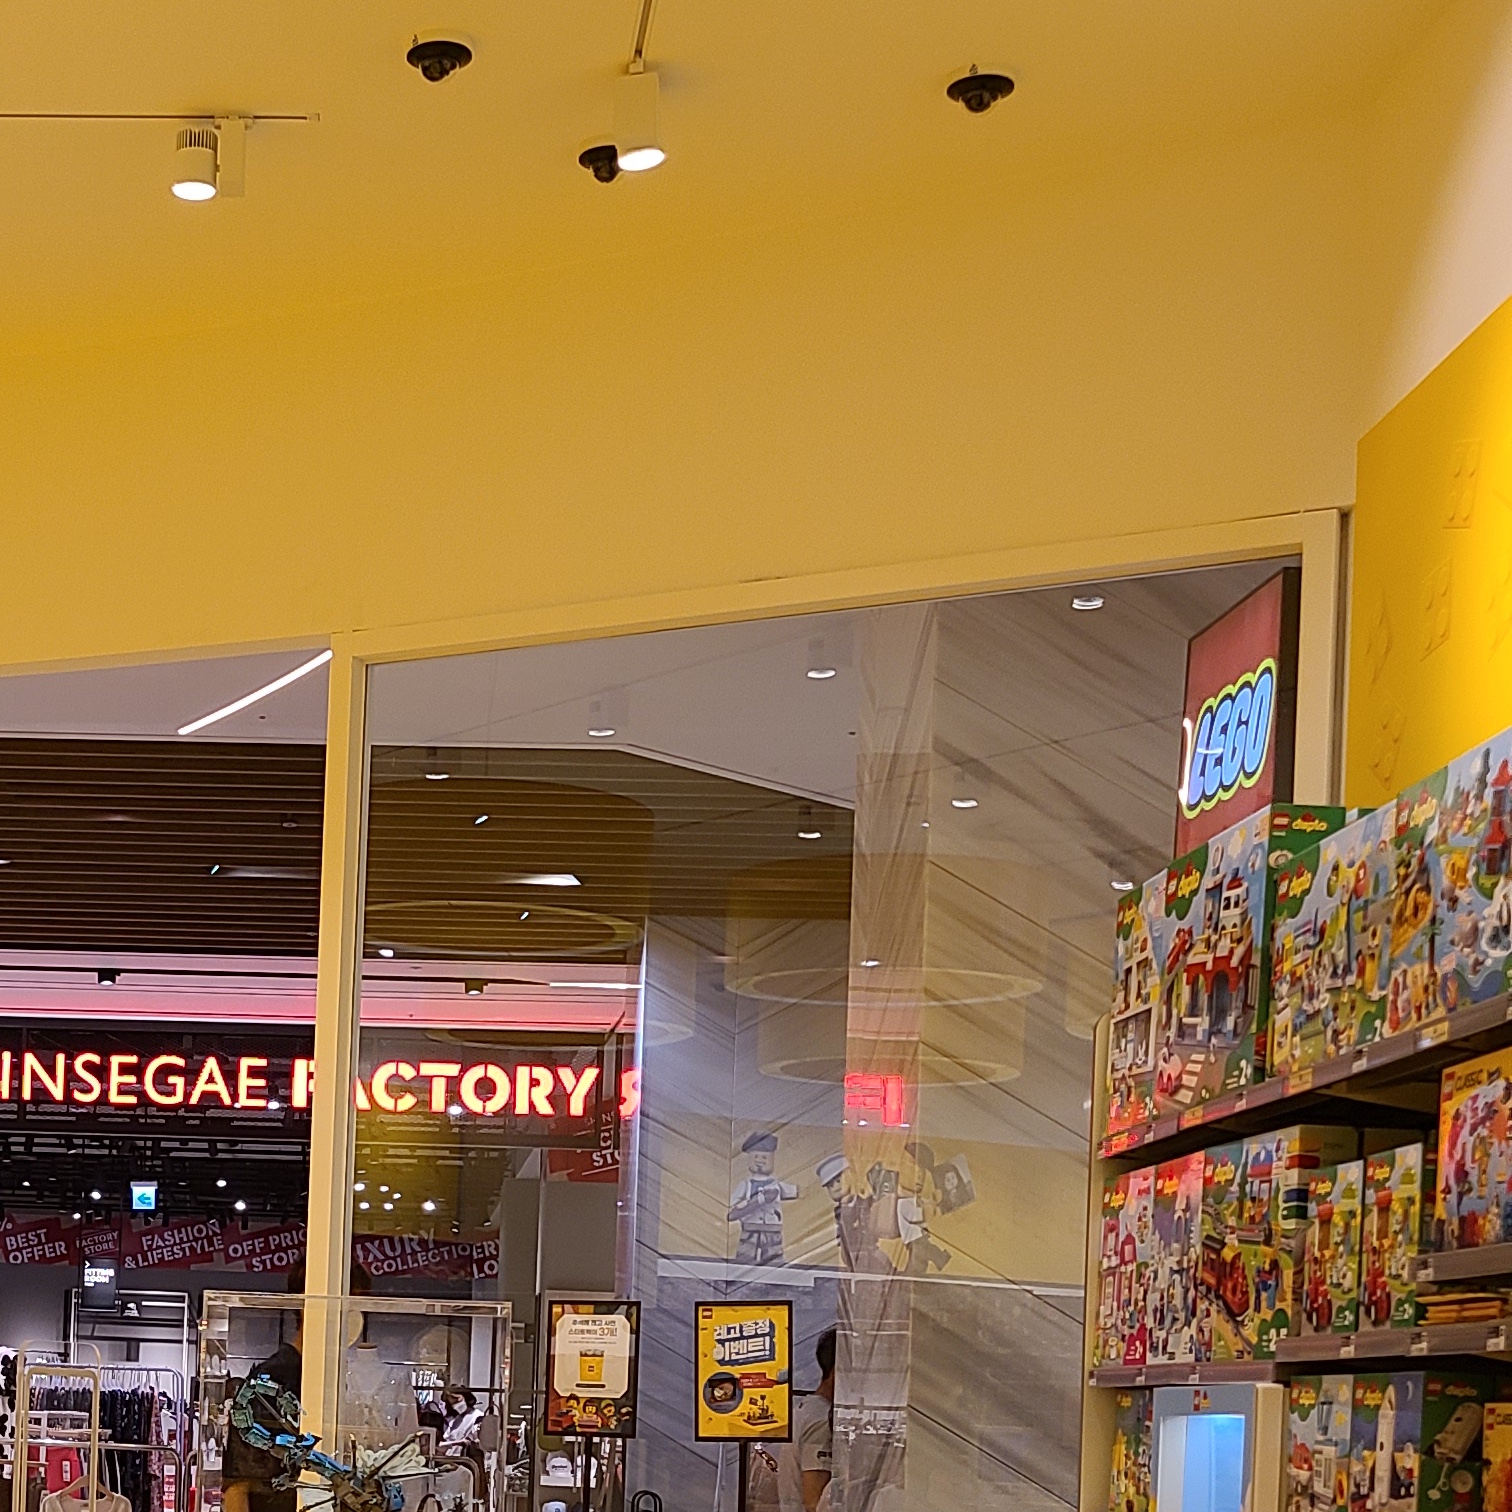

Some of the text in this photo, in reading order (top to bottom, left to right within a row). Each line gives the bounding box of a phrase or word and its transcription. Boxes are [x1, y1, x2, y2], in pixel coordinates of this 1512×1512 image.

[1184, 660, 1276, 815] LEGO
[291, 1057, 601, 1117] FCTORY
[5, 1228, 47, 1250] BEST
[141, 1220, 222, 1251] FASHION
[8, 1241, 68, 1265] OFFER
[84, 1241, 116, 1256] STORE
[228, 1239, 265, 1258] OFF
[714, 1322, 740, 1340] 레고
[713, 1335, 771, 1361] 이벤트!
